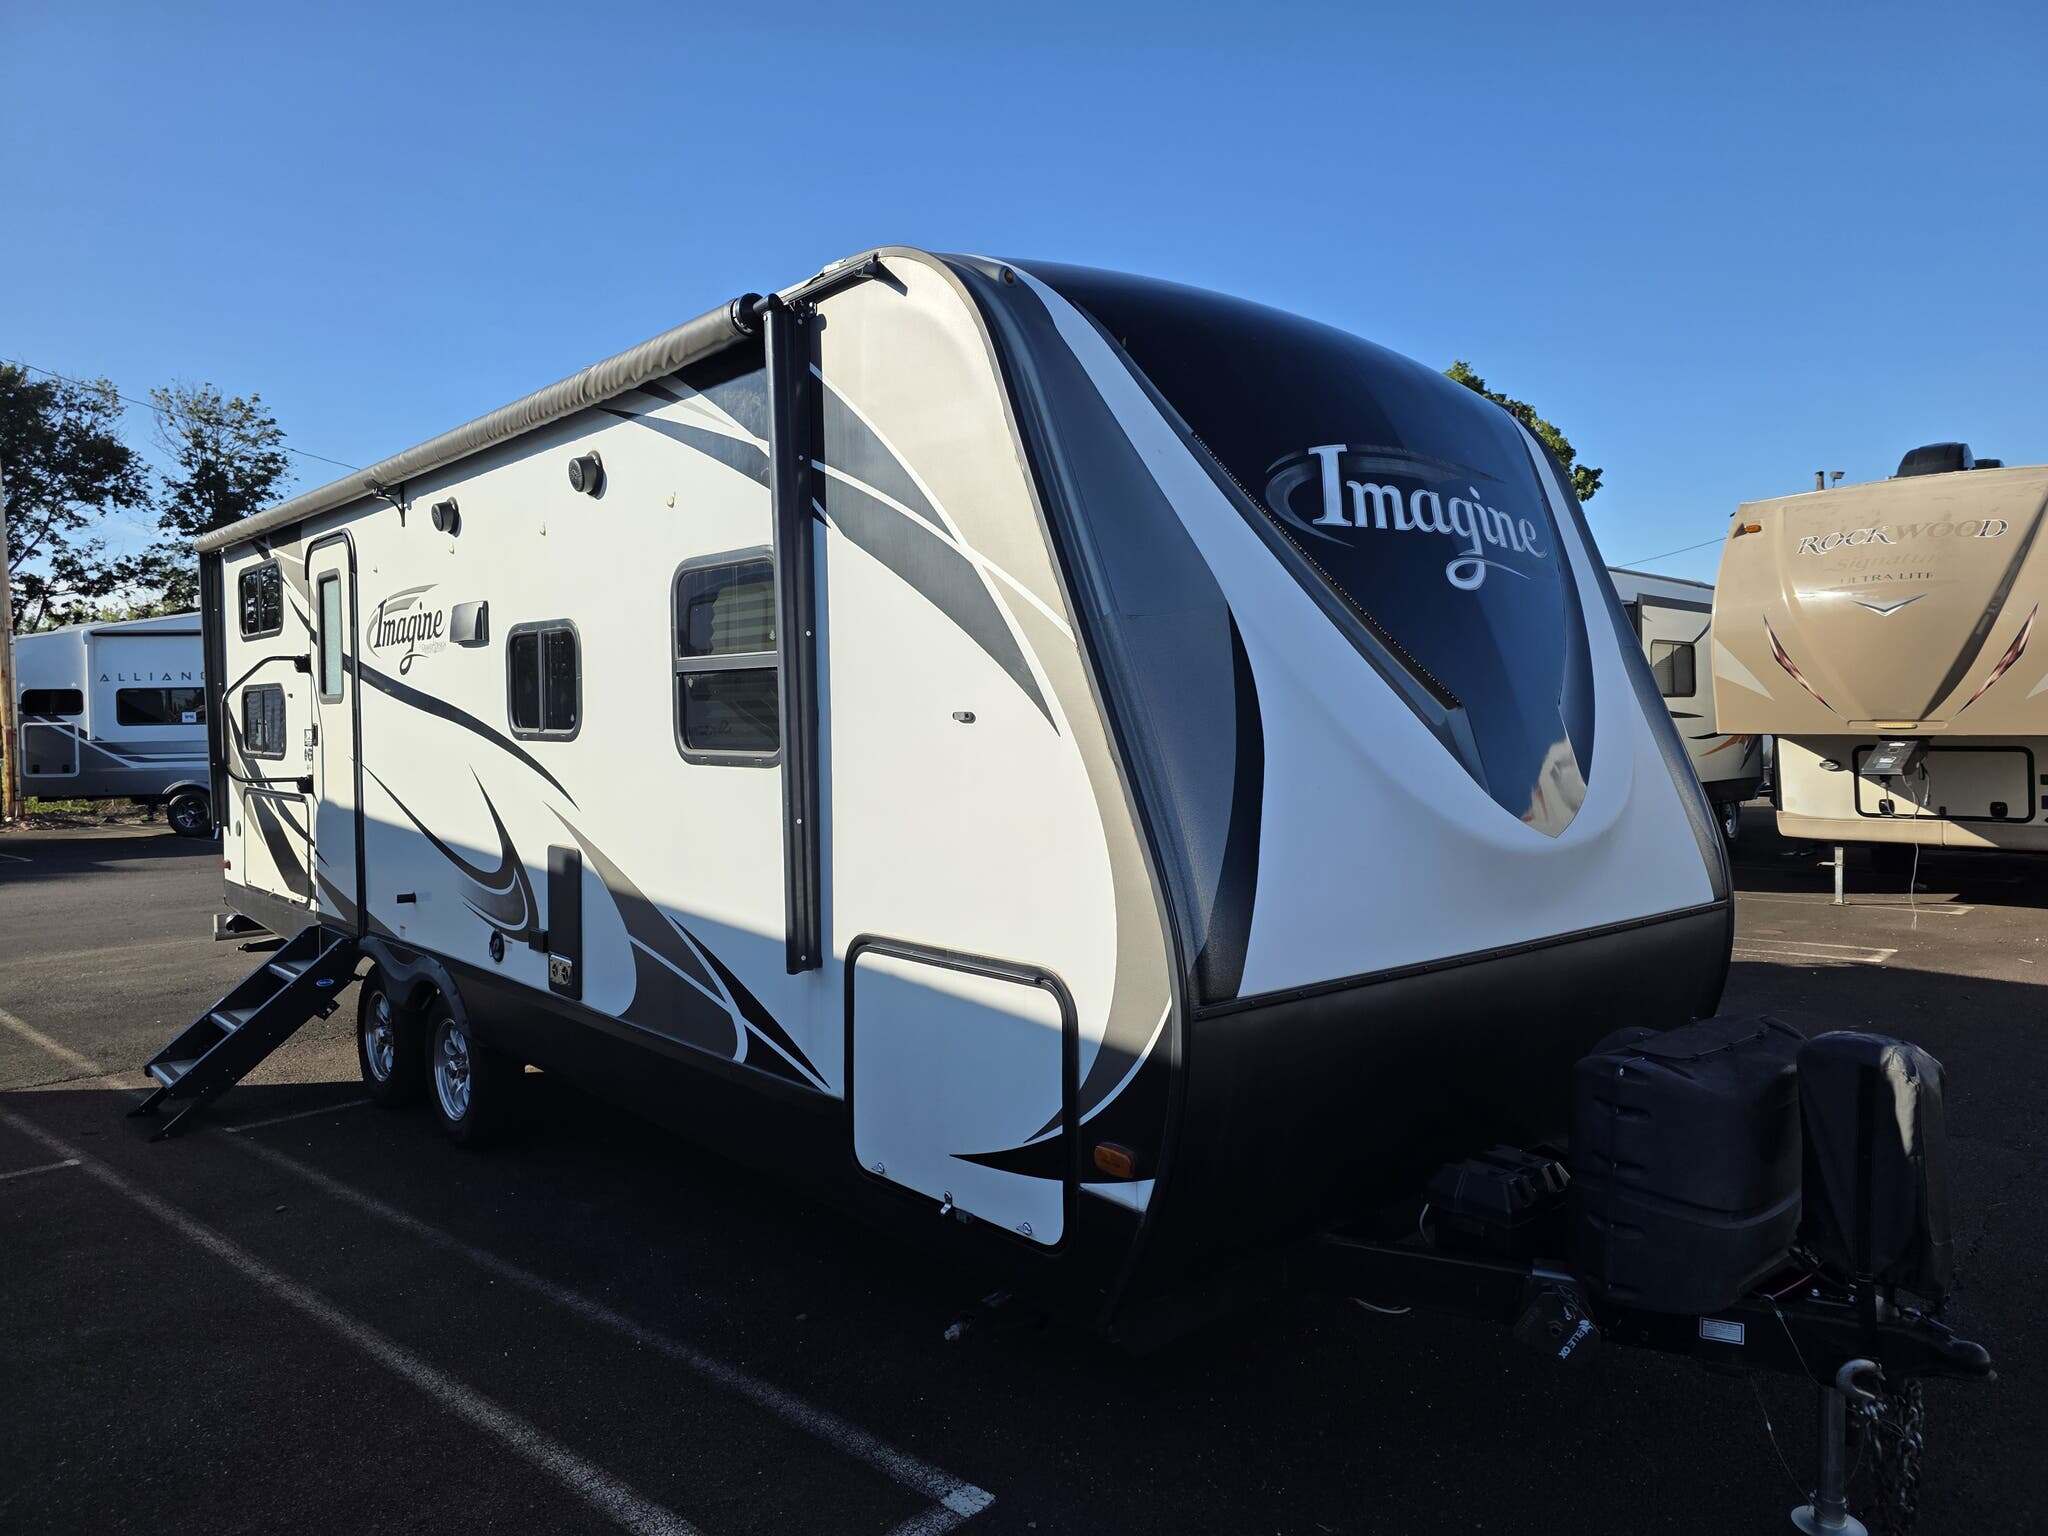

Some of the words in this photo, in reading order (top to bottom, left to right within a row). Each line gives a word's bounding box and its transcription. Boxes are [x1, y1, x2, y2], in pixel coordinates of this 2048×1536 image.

[1308, 443, 1547, 590] Imagine
[1797, 518, 2009, 555] ROCKWOOD
[1899, 570, 1935, 580] LITE
[373, 598, 446, 675] Imagine
